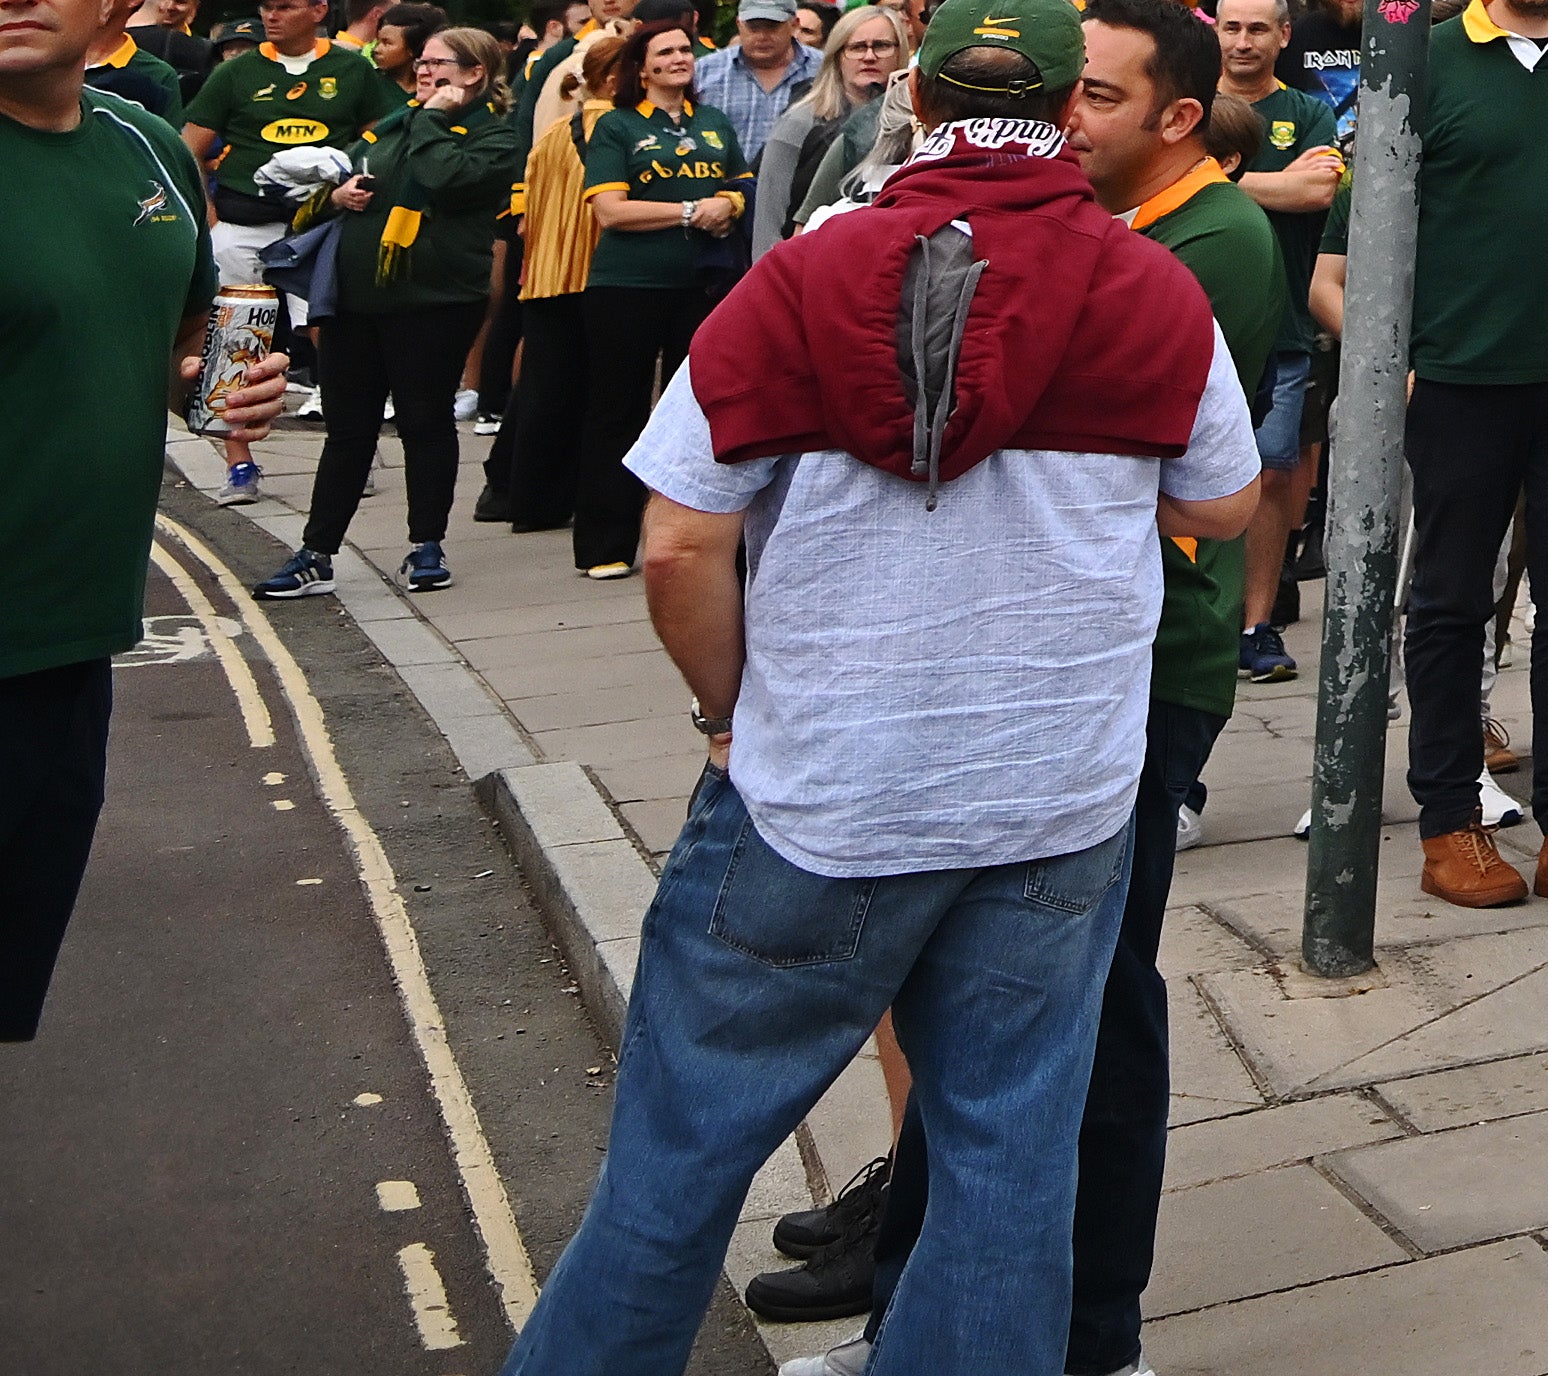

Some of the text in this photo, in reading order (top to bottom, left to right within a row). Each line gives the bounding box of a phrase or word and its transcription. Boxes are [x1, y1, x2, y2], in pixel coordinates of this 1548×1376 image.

[1304, 51, 1353, 69] IRON
[275, 125, 317, 138] MTN
[677, 161, 725, 179] ABS
